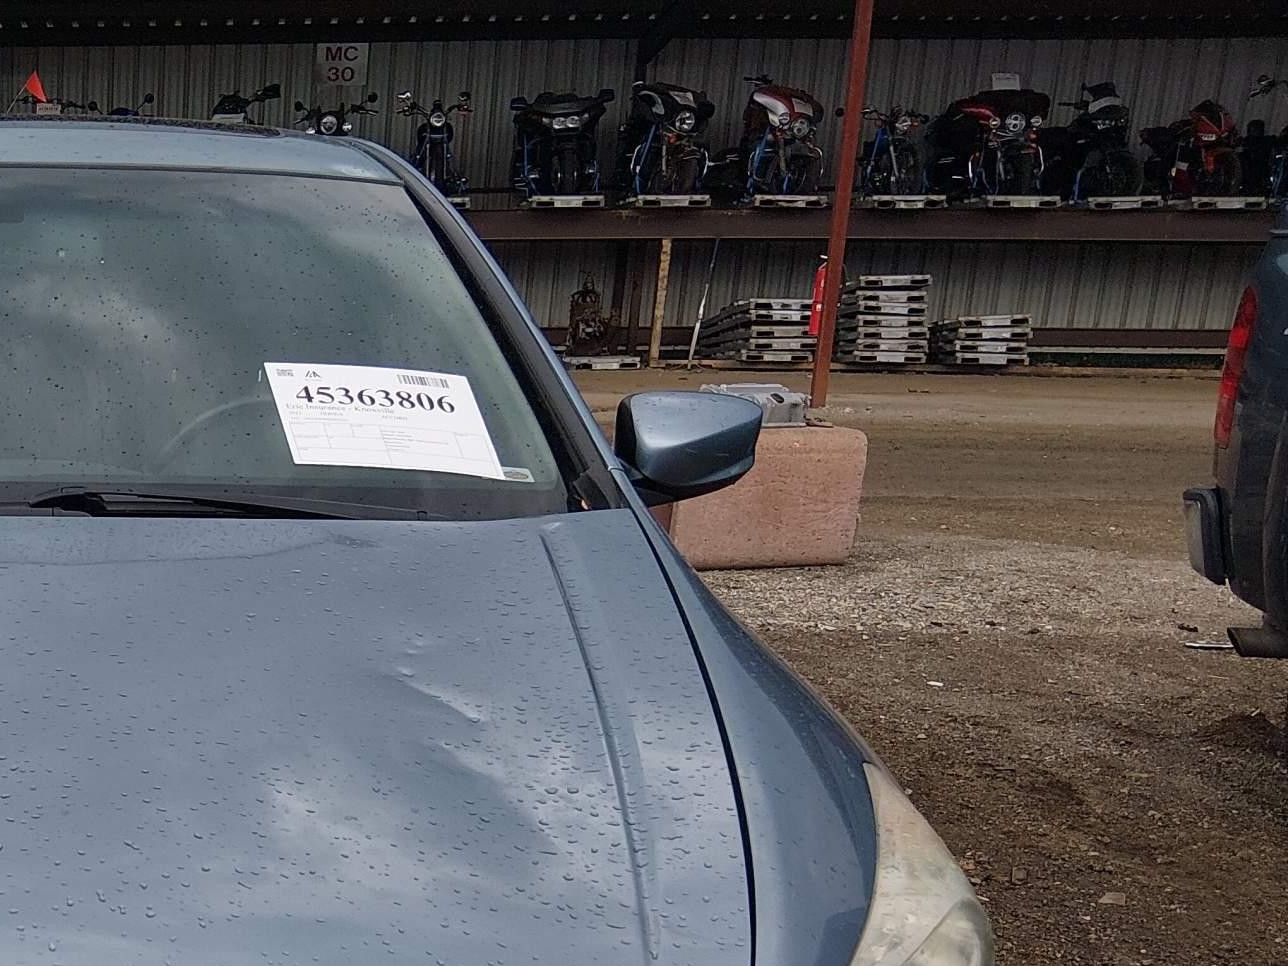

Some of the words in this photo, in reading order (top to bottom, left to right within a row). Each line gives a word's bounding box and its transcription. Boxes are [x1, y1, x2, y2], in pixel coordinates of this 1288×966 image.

[325, 46, 359, 61] MC
[327, 67, 354, 82] 30
[296, 385, 455, 413] 45363806
